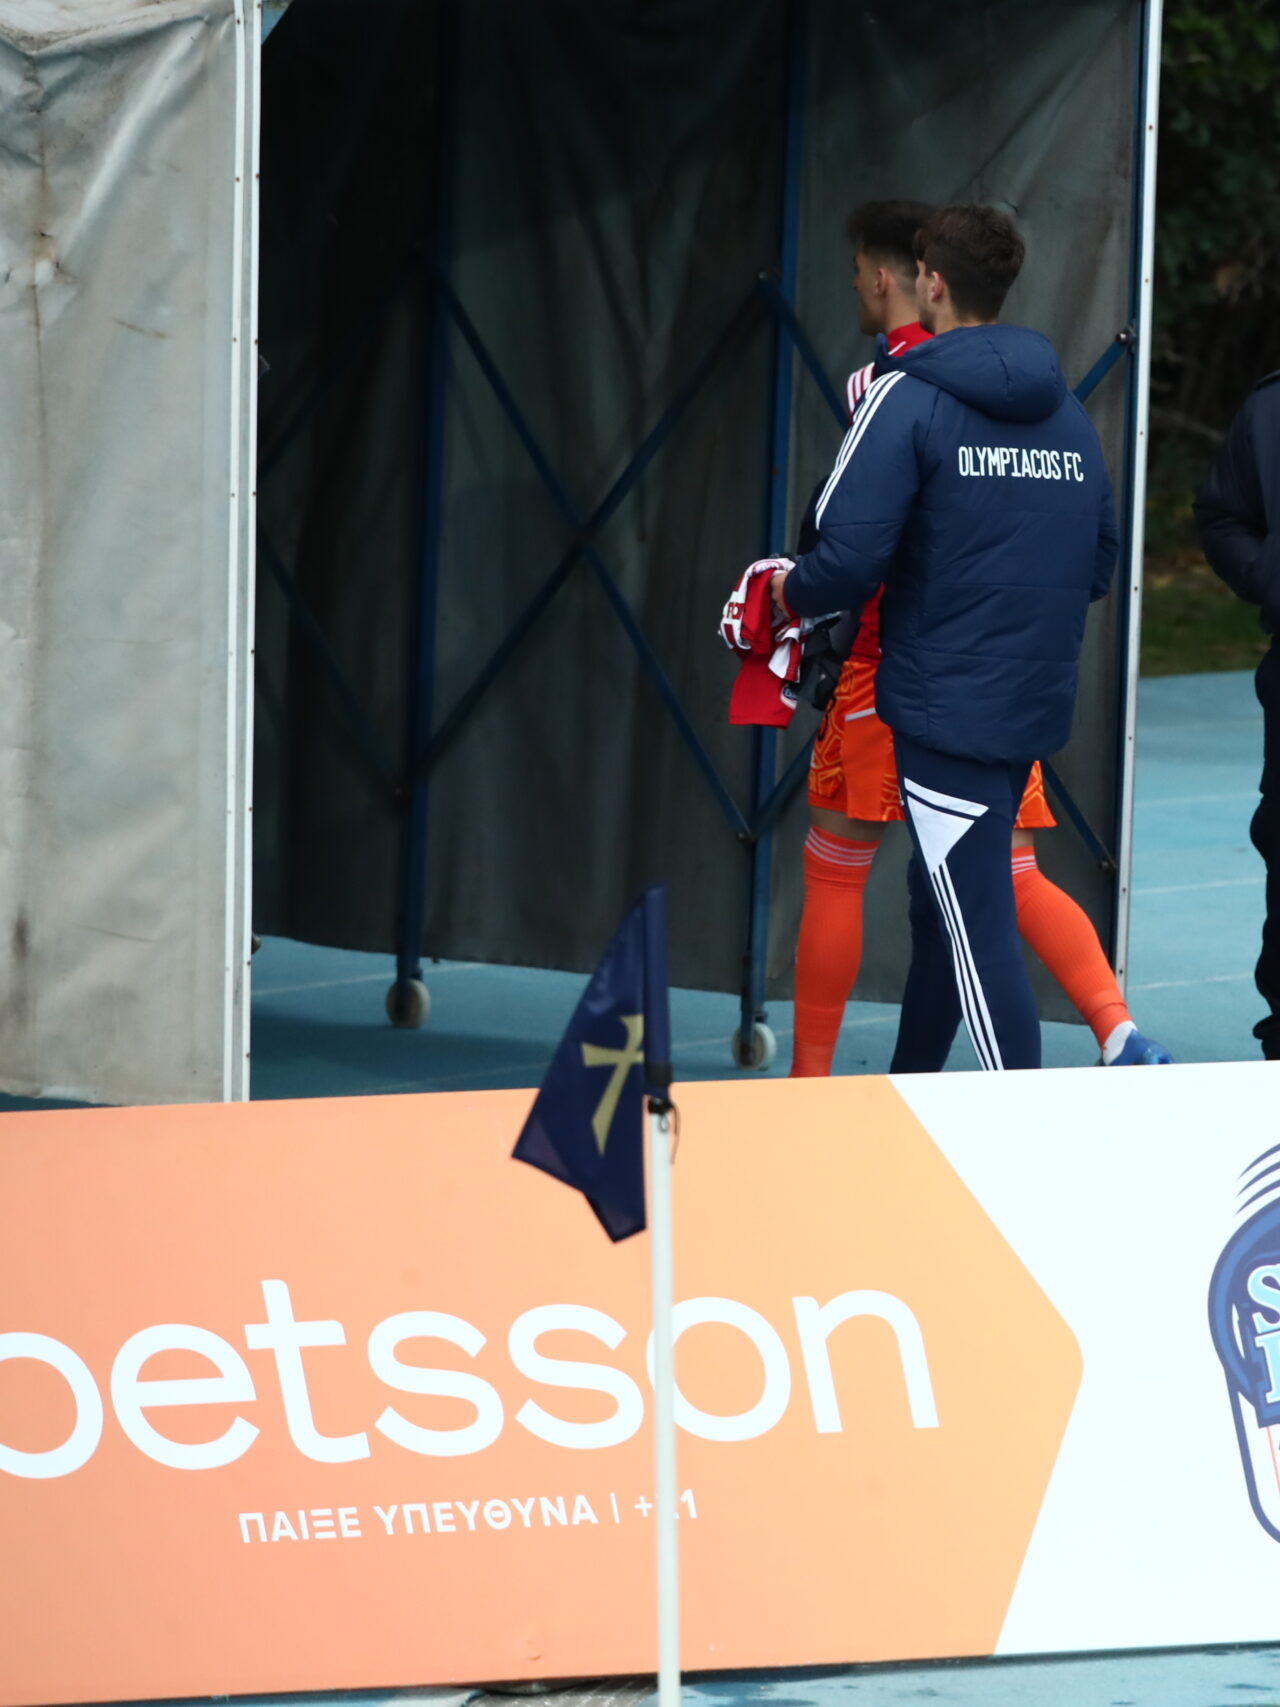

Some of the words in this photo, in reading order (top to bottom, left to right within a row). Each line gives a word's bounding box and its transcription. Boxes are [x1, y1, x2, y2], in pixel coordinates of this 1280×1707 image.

[958, 446, 1062, 480] OLYMPIACOS
[1063, 451, 1084, 482] FC
[239, 1506, 362, 1544] ΠΑΙΞΕ
[374, 1494, 600, 1536] ΥΠΕΥΘΥΝΑ
[633, 1488, 698, 1519] +1
